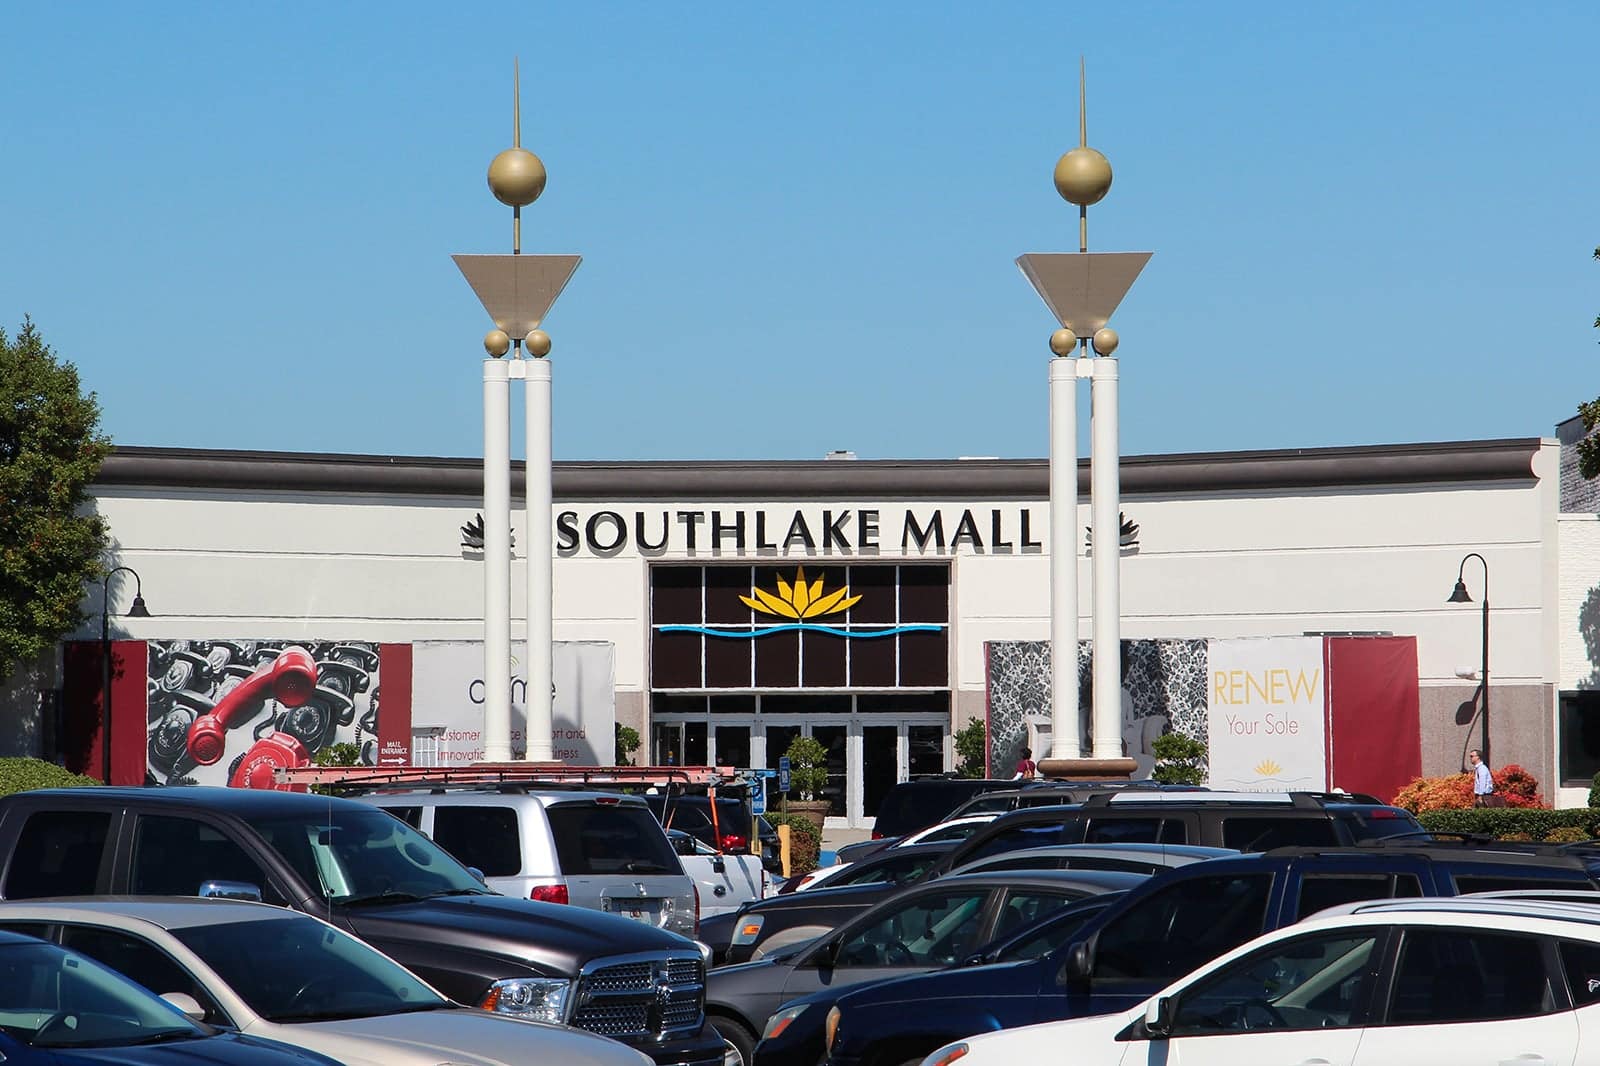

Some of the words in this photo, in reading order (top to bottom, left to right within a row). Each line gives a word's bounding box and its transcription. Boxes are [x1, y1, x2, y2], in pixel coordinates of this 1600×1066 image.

[556, 509, 880, 554] SOUTHLAKE
[901, 508, 1042, 553] MALL
[1214, 668, 1320, 705] RENEW
[565, 726, 586, 740] and
[1225, 713, 1259, 735] Your
[1264, 711, 1299, 735] Sole
